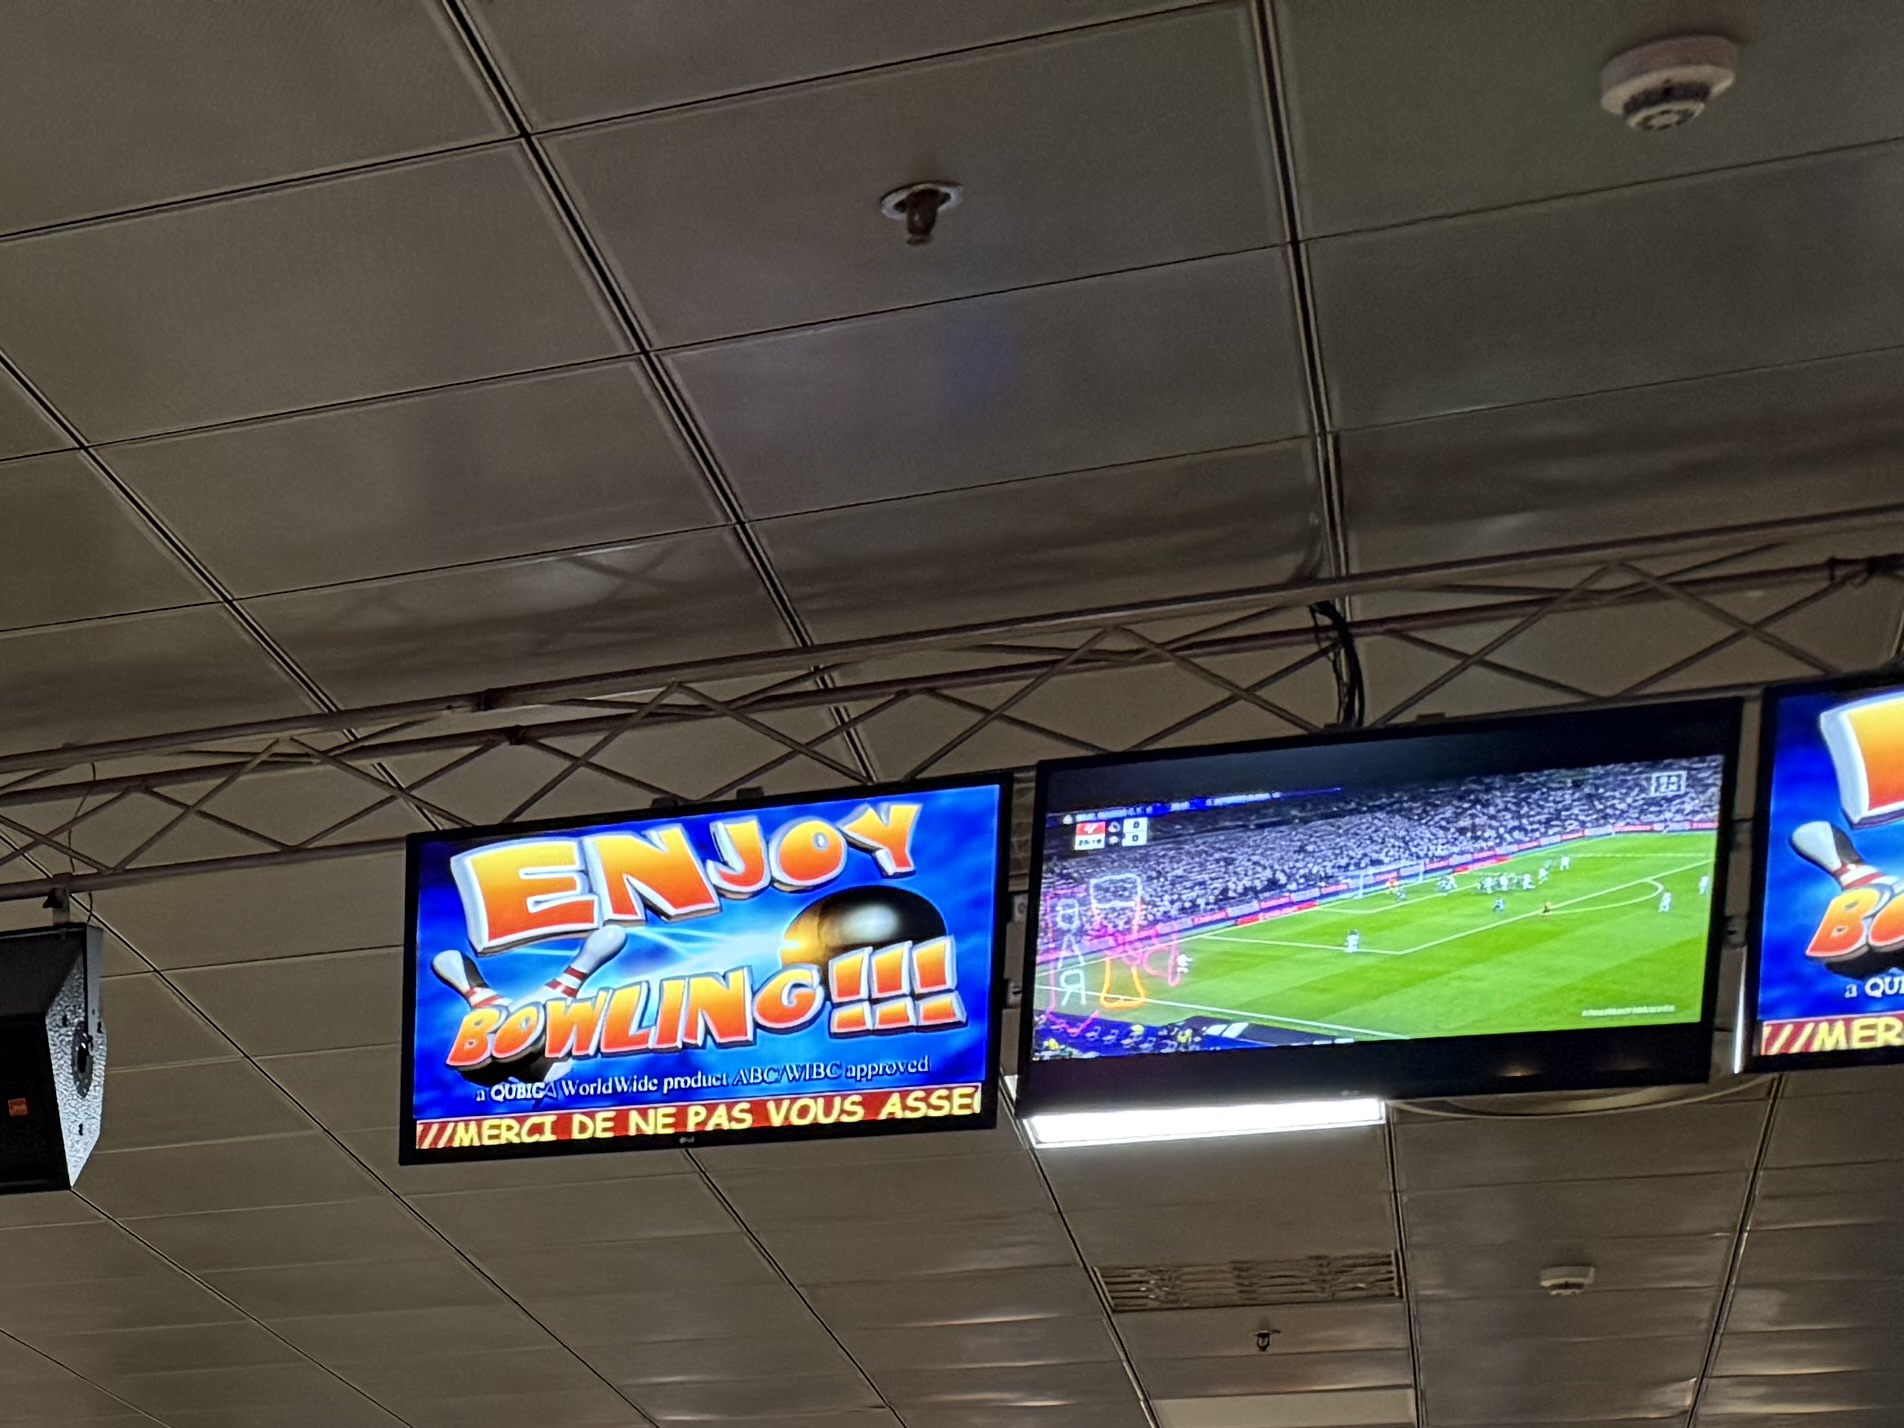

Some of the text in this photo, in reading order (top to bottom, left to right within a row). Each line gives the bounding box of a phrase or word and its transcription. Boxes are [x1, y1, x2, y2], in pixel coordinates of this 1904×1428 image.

[449, 801, 922, 957] ENJOY
[846, 1055, 930, 1080] approved
[572, 1112, 616, 1141] DE
[628, 1109, 676, 1138] NE
[687, 1102, 753, 1133] PAS
[769, 1094, 865, 1128] VOUS
